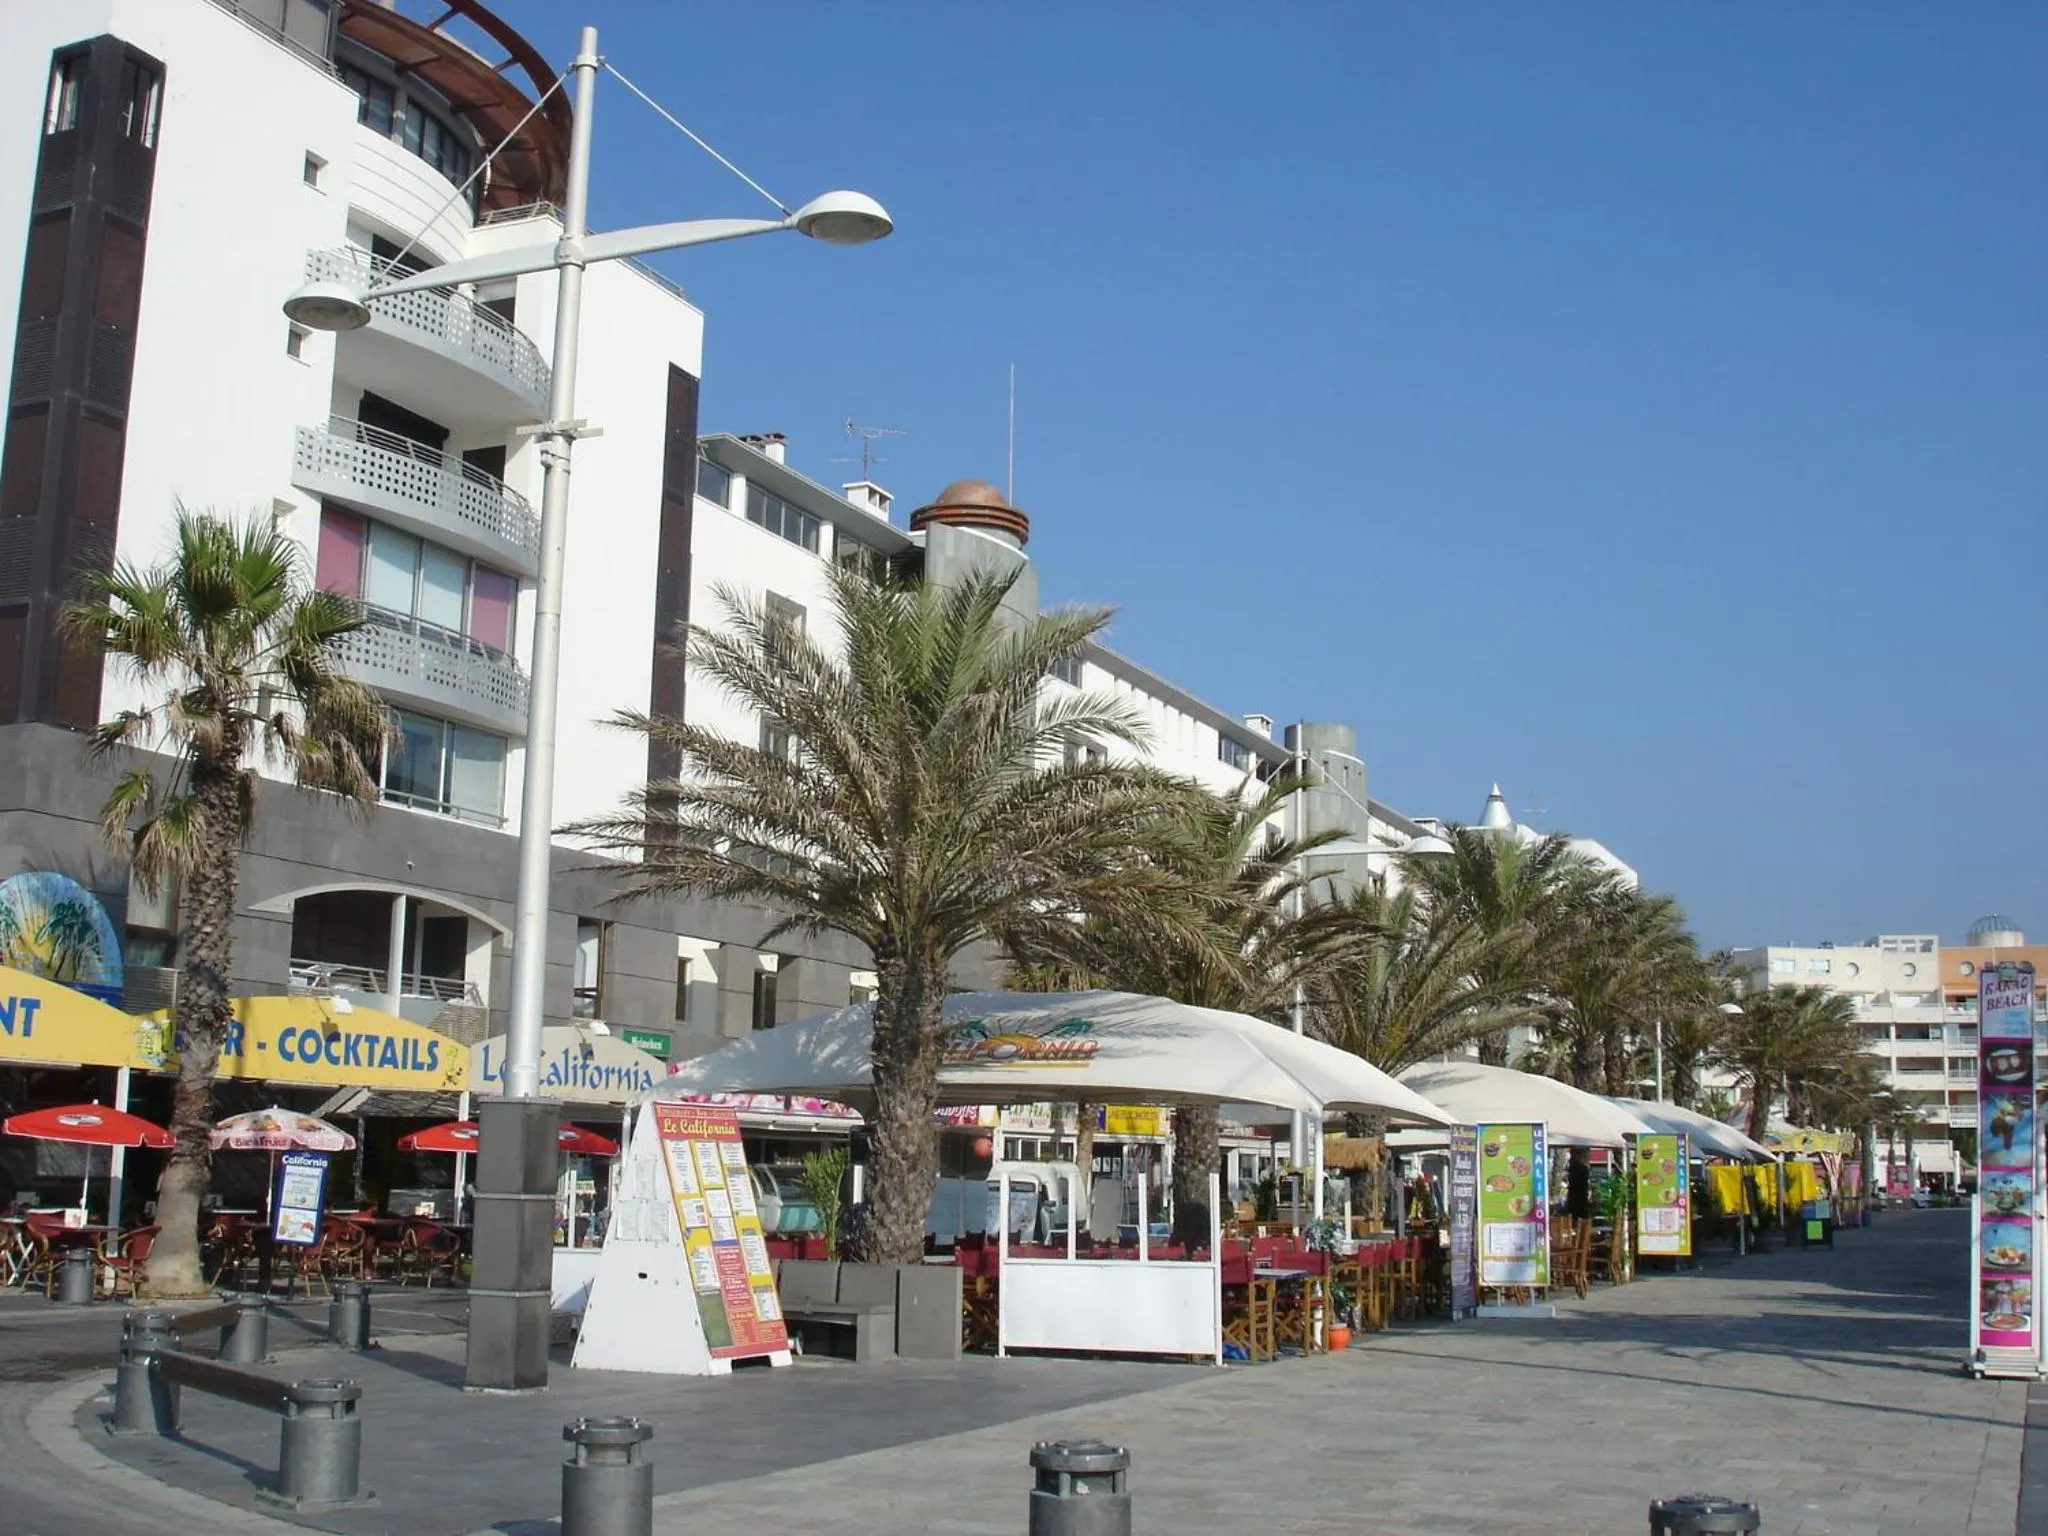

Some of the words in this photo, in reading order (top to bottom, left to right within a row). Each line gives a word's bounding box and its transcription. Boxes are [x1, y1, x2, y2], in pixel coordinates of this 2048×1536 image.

[1986, 992, 2028, 1012] BEACH
[278, 1027, 439, 1072] COCKTAILS
[663, 1118, 677, 1133] Le
[680, 1119, 736, 1138] California
[282, 1155, 328, 1167] California
